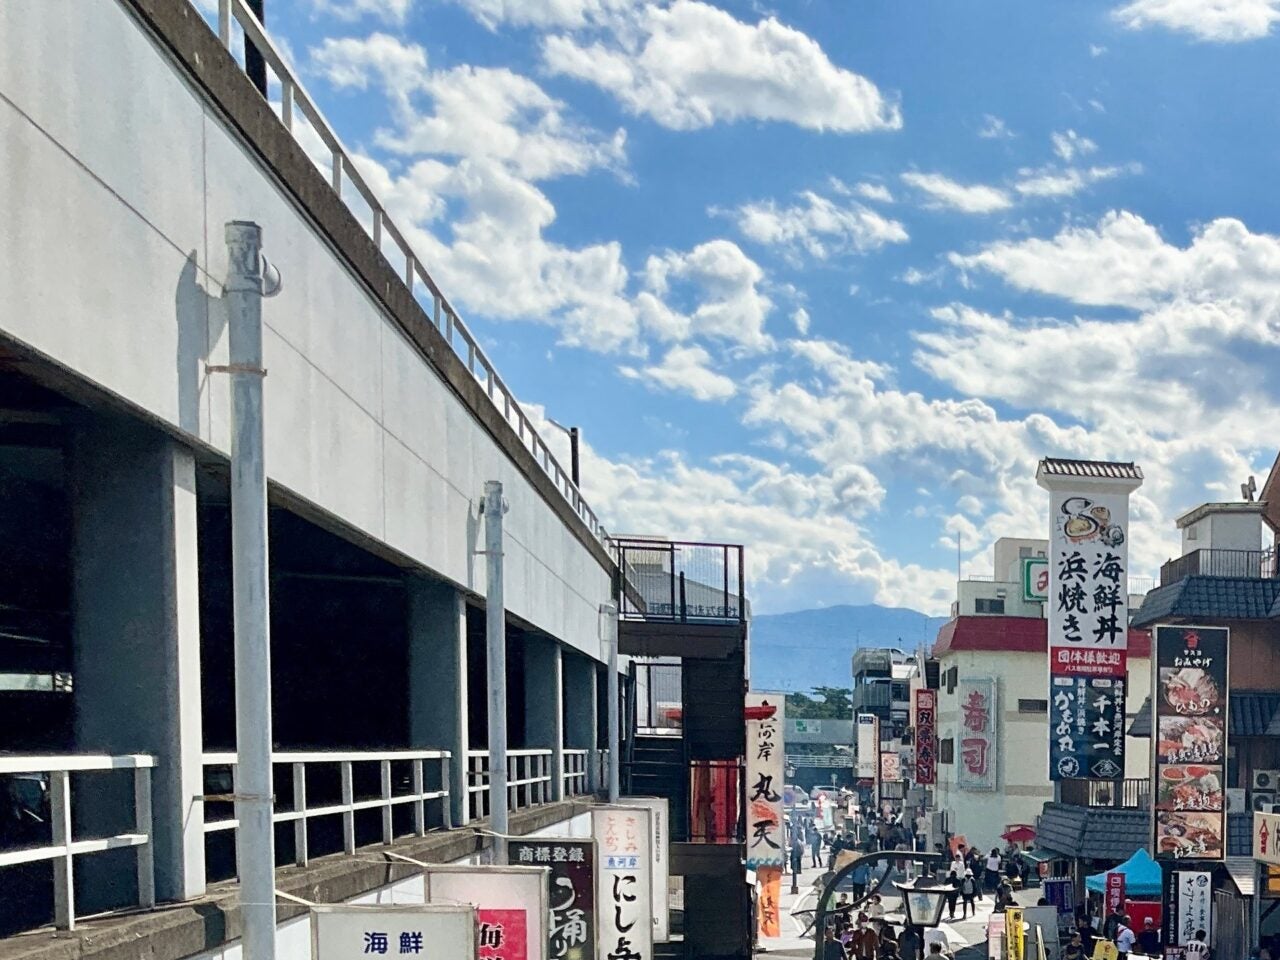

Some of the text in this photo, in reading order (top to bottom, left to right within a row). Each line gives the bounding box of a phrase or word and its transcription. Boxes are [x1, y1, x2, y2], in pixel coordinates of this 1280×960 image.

[1058, 552, 1088, 644] 浜焼き
[1093, 553, 1123, 645] 海鮮丼
[1058, 650, 1120, 665] 団体様歓迎
[1174, 657, 1212, 667] おみやげ
[961, 690, 988, 776] 寿司
[1054, 690, 1075, 752] かもめ丸
[1092, 695, 1111, 749] 千本一
[750, 773, 781, 849] 丸天
[519, 845, 584, 863] 商標登録
[364, 932, 424, 954] 海鮮
